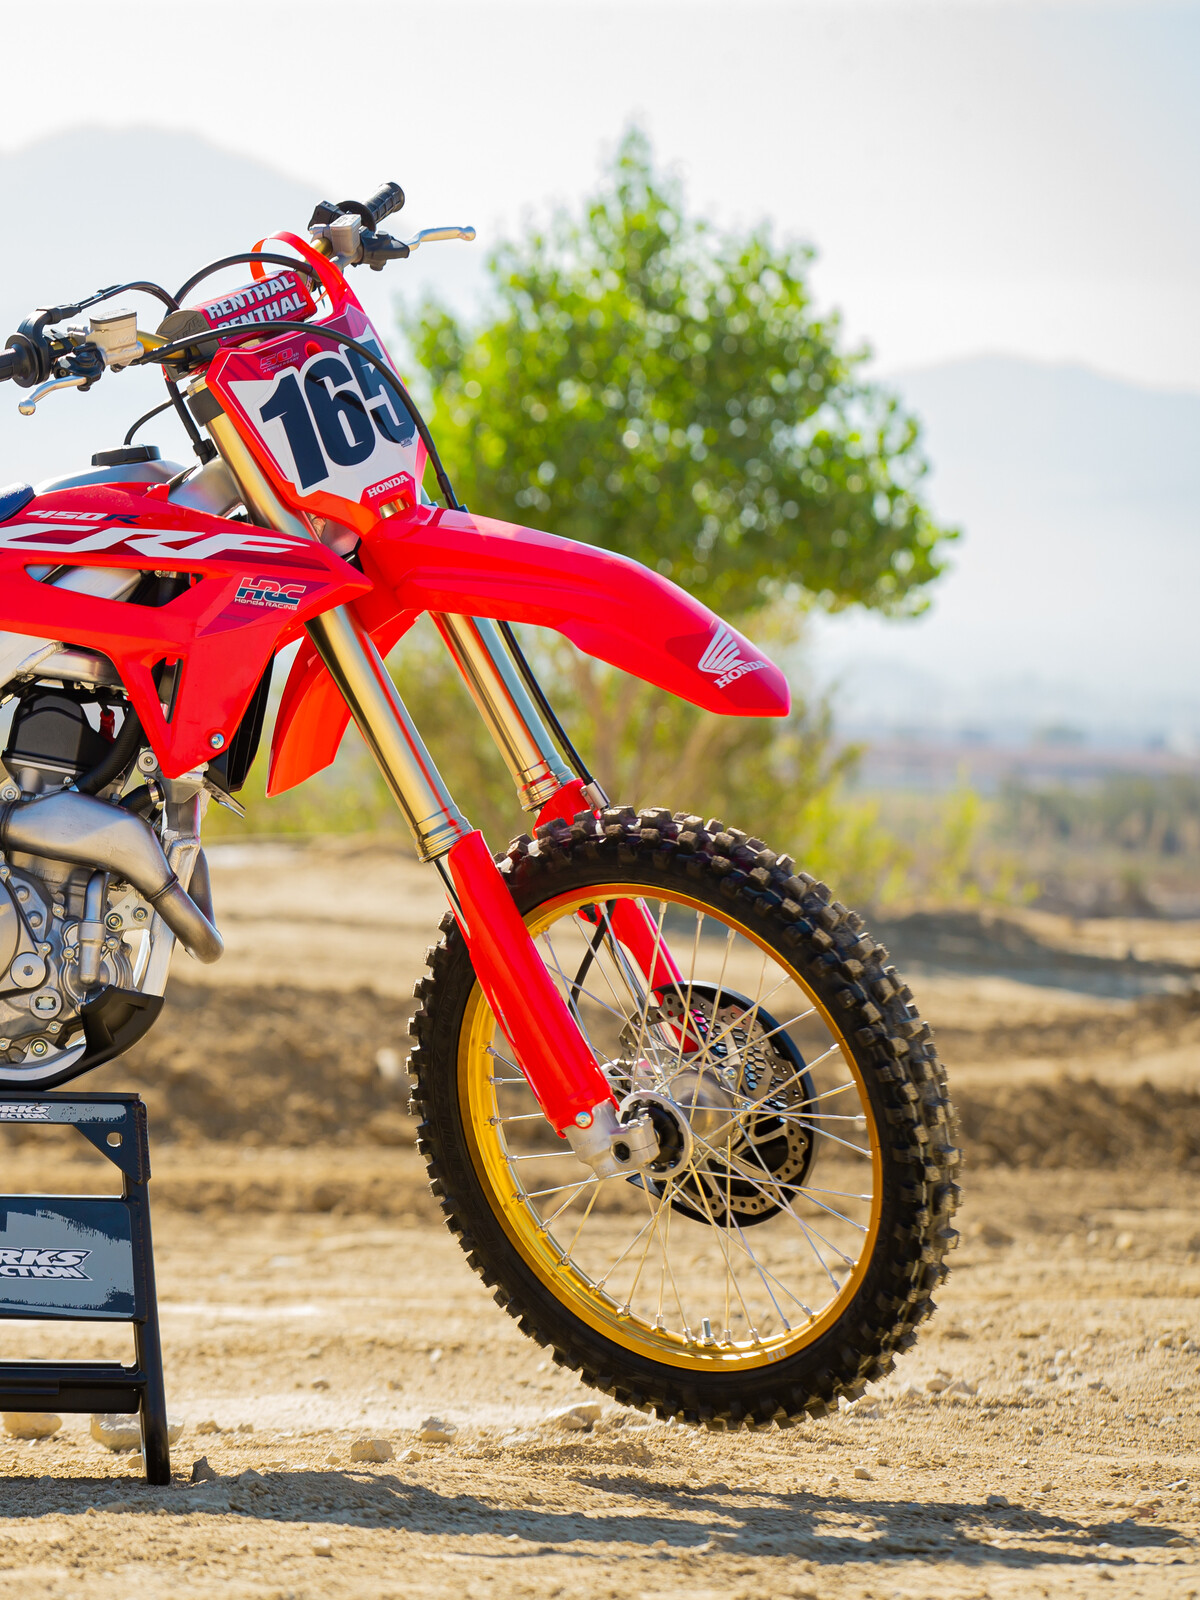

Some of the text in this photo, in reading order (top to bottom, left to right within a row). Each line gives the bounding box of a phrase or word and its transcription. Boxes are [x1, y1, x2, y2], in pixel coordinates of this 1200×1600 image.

[204, 275, 296, 320] RENTHAL
[259, 338, 416, 490] 165
[366, 474, 409, 498] HONDA
[26, 510, 141, 525] 450R
[235, 577, 307, 606] HRC
[265, 601, 298, 611] RACING
[713, 660, 769, 689] HONDA
